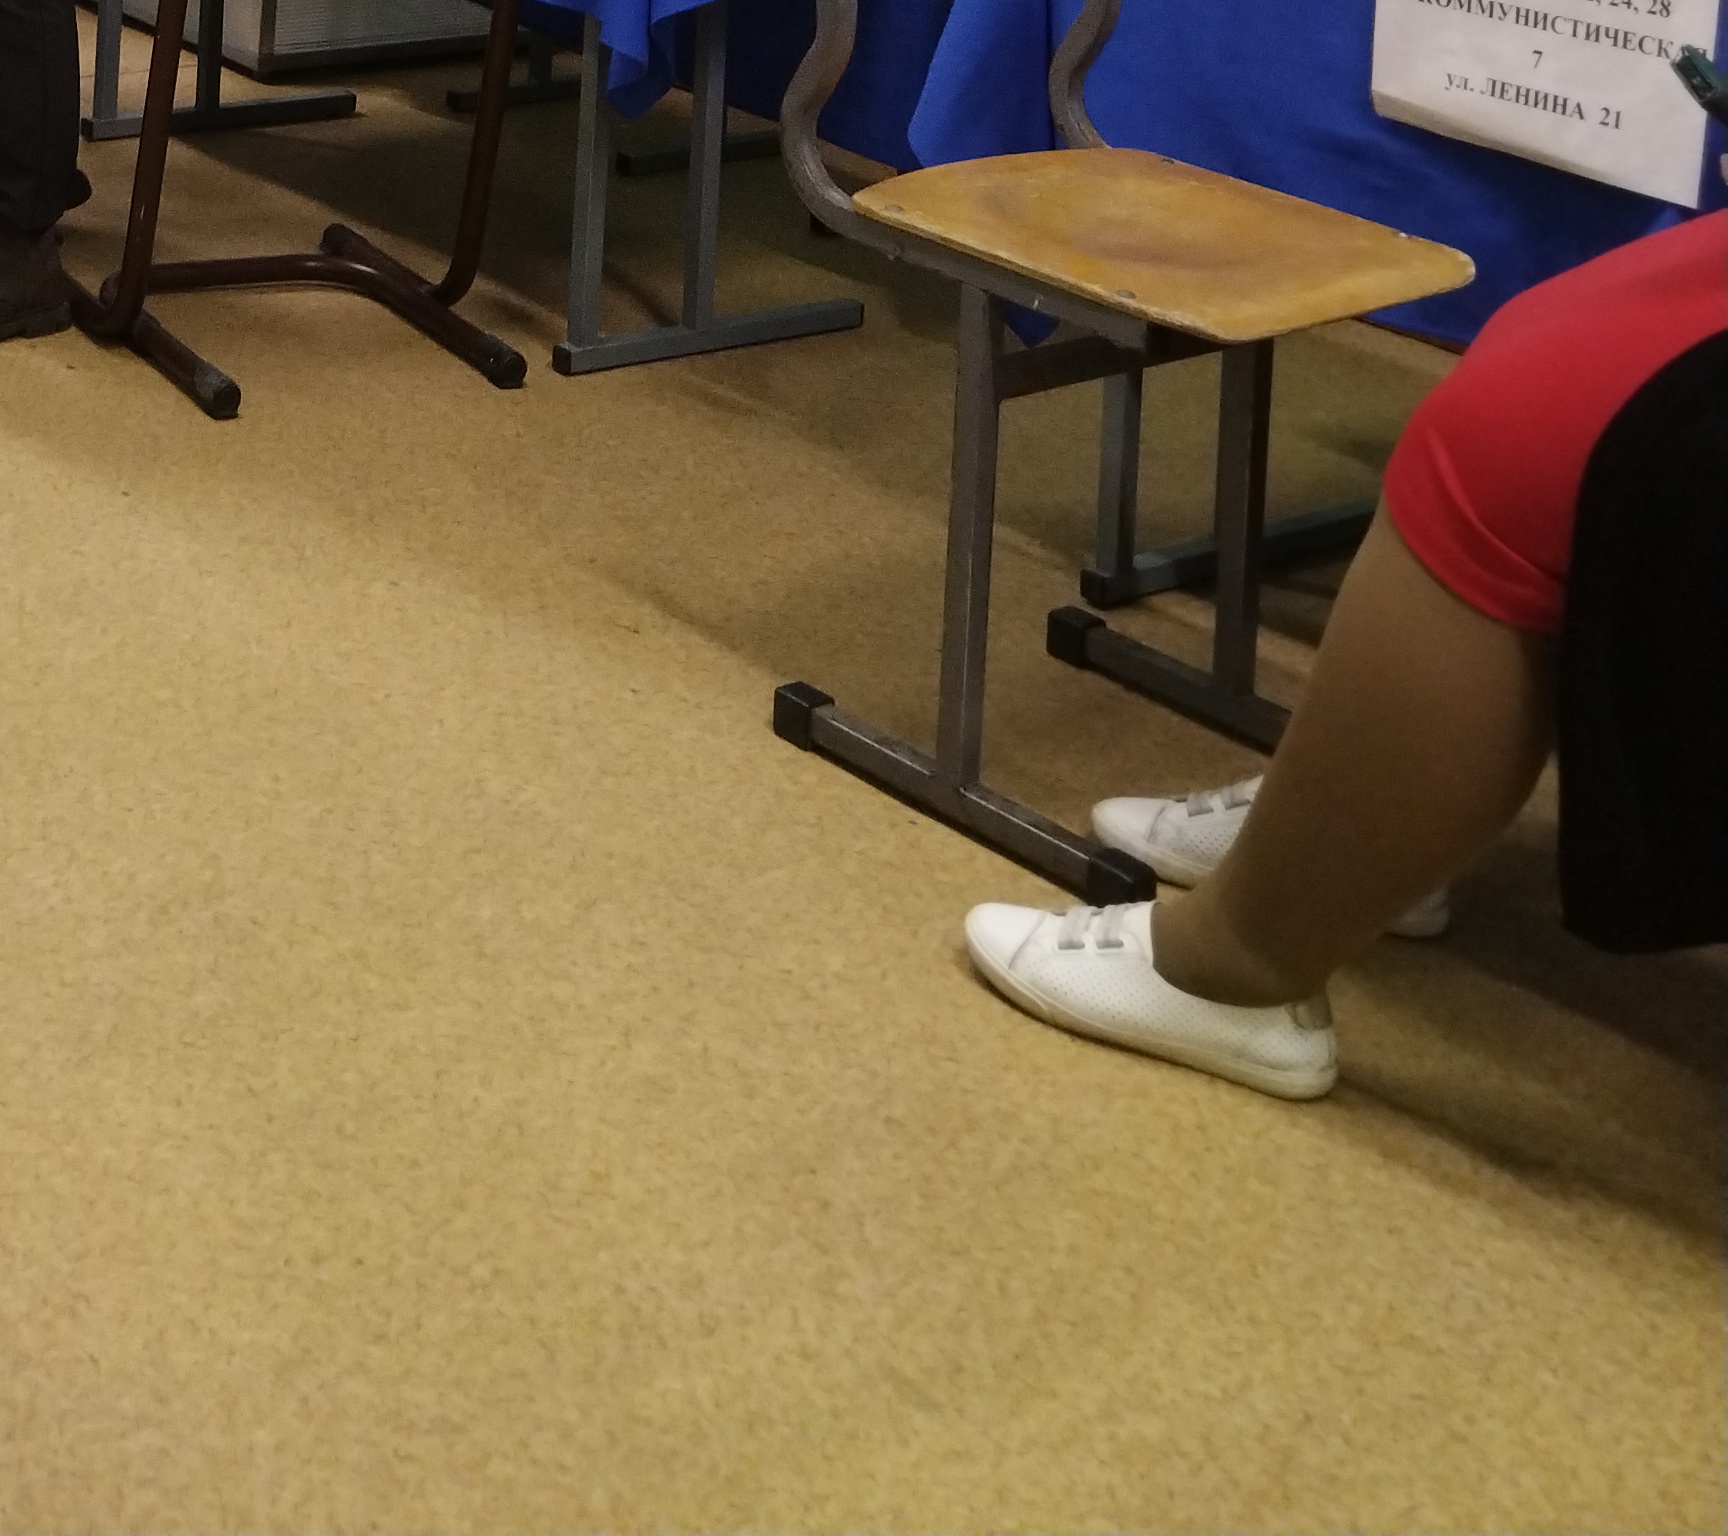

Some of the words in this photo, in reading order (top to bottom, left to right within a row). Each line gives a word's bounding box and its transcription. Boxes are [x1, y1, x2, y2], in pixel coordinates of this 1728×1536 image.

[1531, 50, 1544, 69] 7
[1444, 72, 1474, 92] ул.
[1479, 77, 1585, 121] ЛЕНИНА
[1598, 107, 1622, 130] 21
